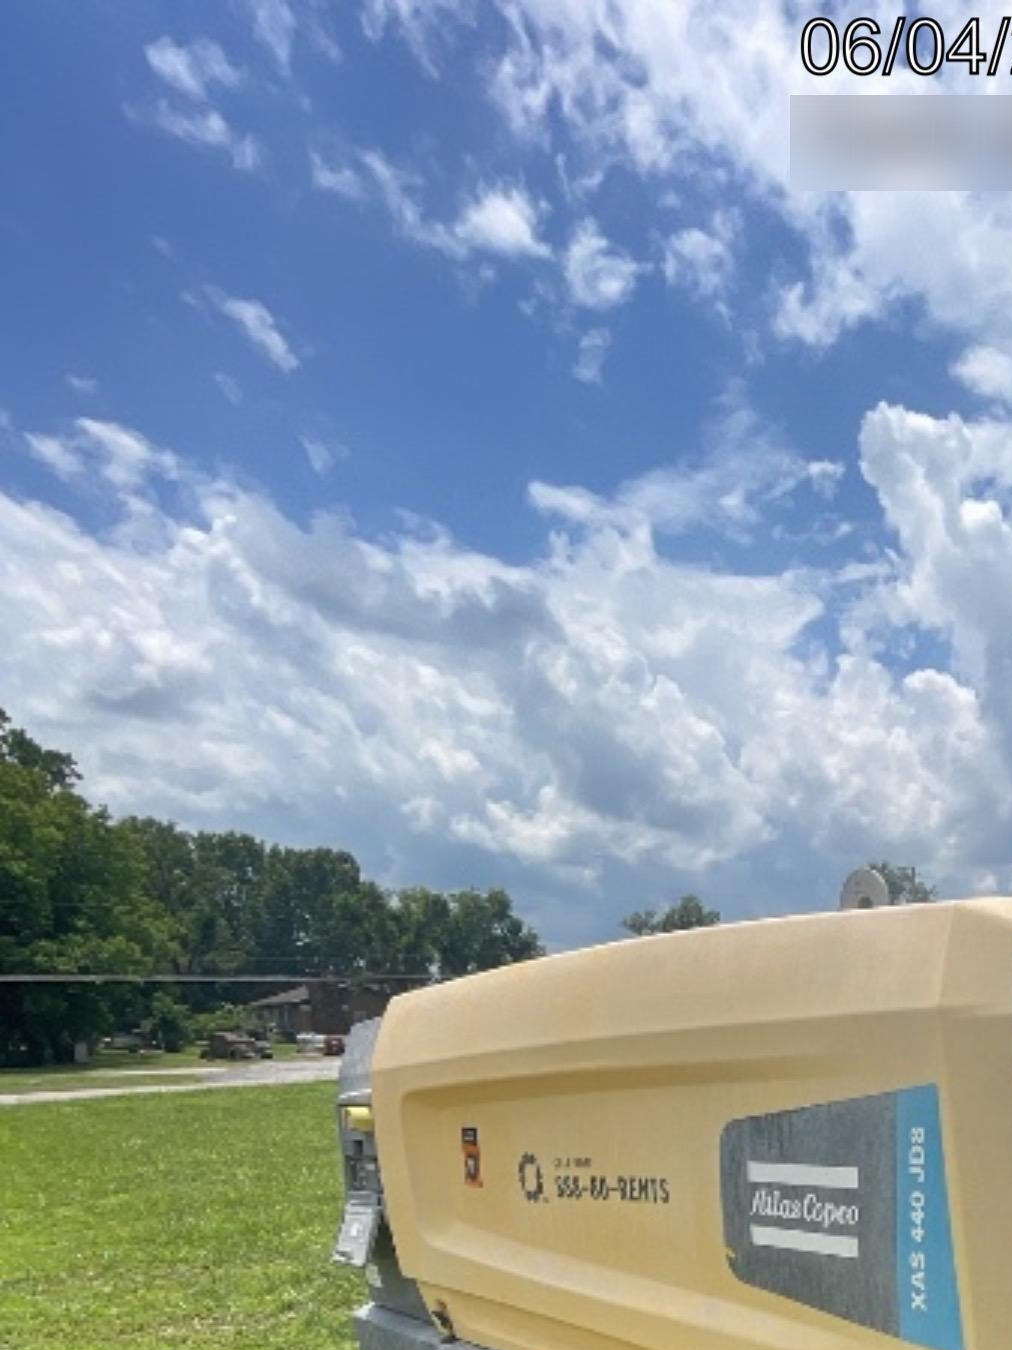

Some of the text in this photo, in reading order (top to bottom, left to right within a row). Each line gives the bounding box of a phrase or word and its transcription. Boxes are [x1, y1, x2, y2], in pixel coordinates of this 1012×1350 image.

[749, 1190, 859, 1228] Atlas Copco
[908, 1126, 927, 1312] XAS 440 JD8
